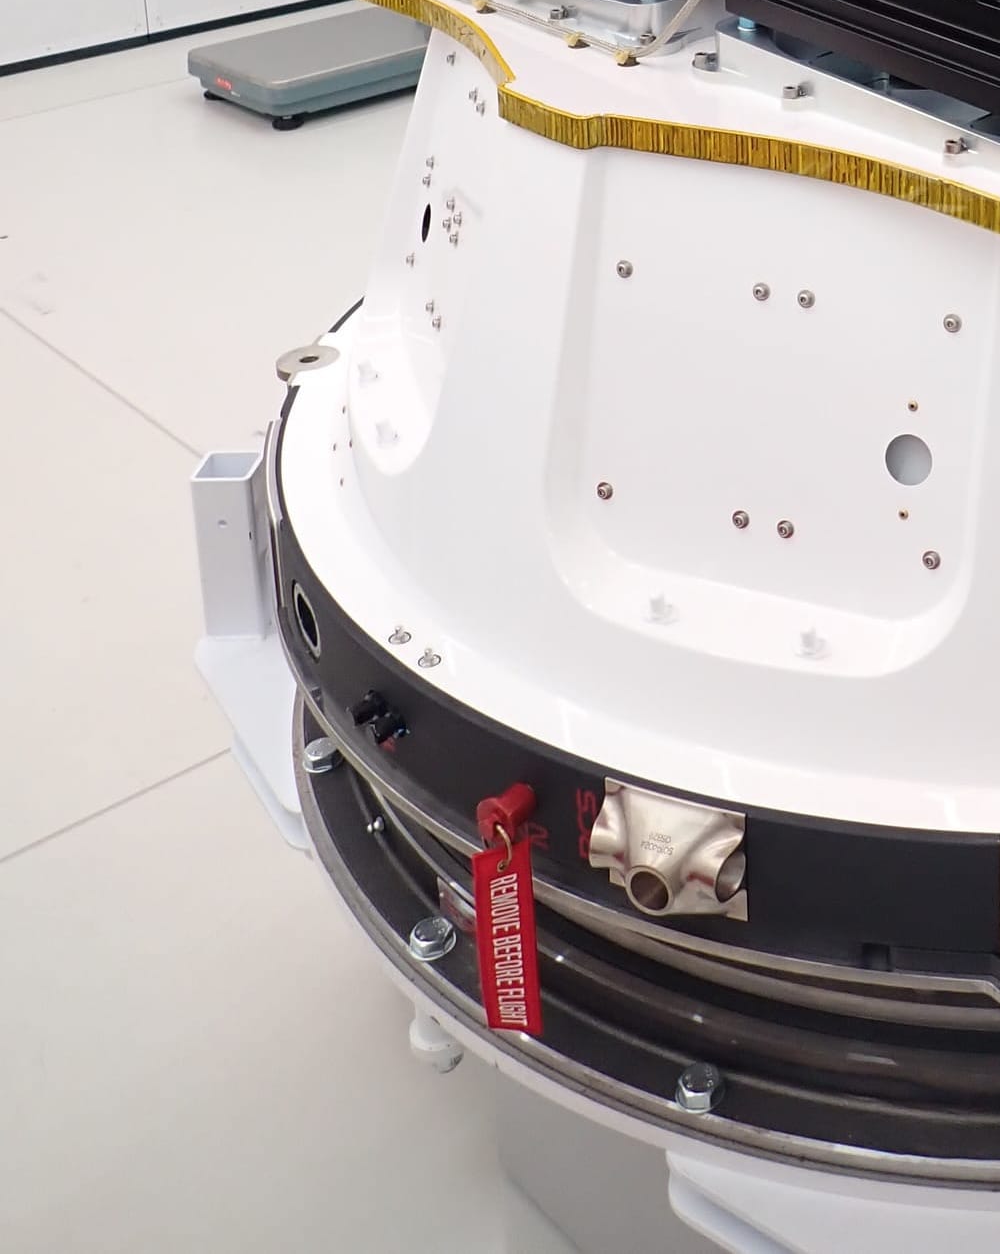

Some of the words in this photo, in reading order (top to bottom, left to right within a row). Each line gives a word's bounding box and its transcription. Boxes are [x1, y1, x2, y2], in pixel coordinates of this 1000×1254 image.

[490, 873, 520, 934] REMOVE
[493, 933, 524, 986] BEFORE
[497, 988, 528, 1026] FLIGHT
